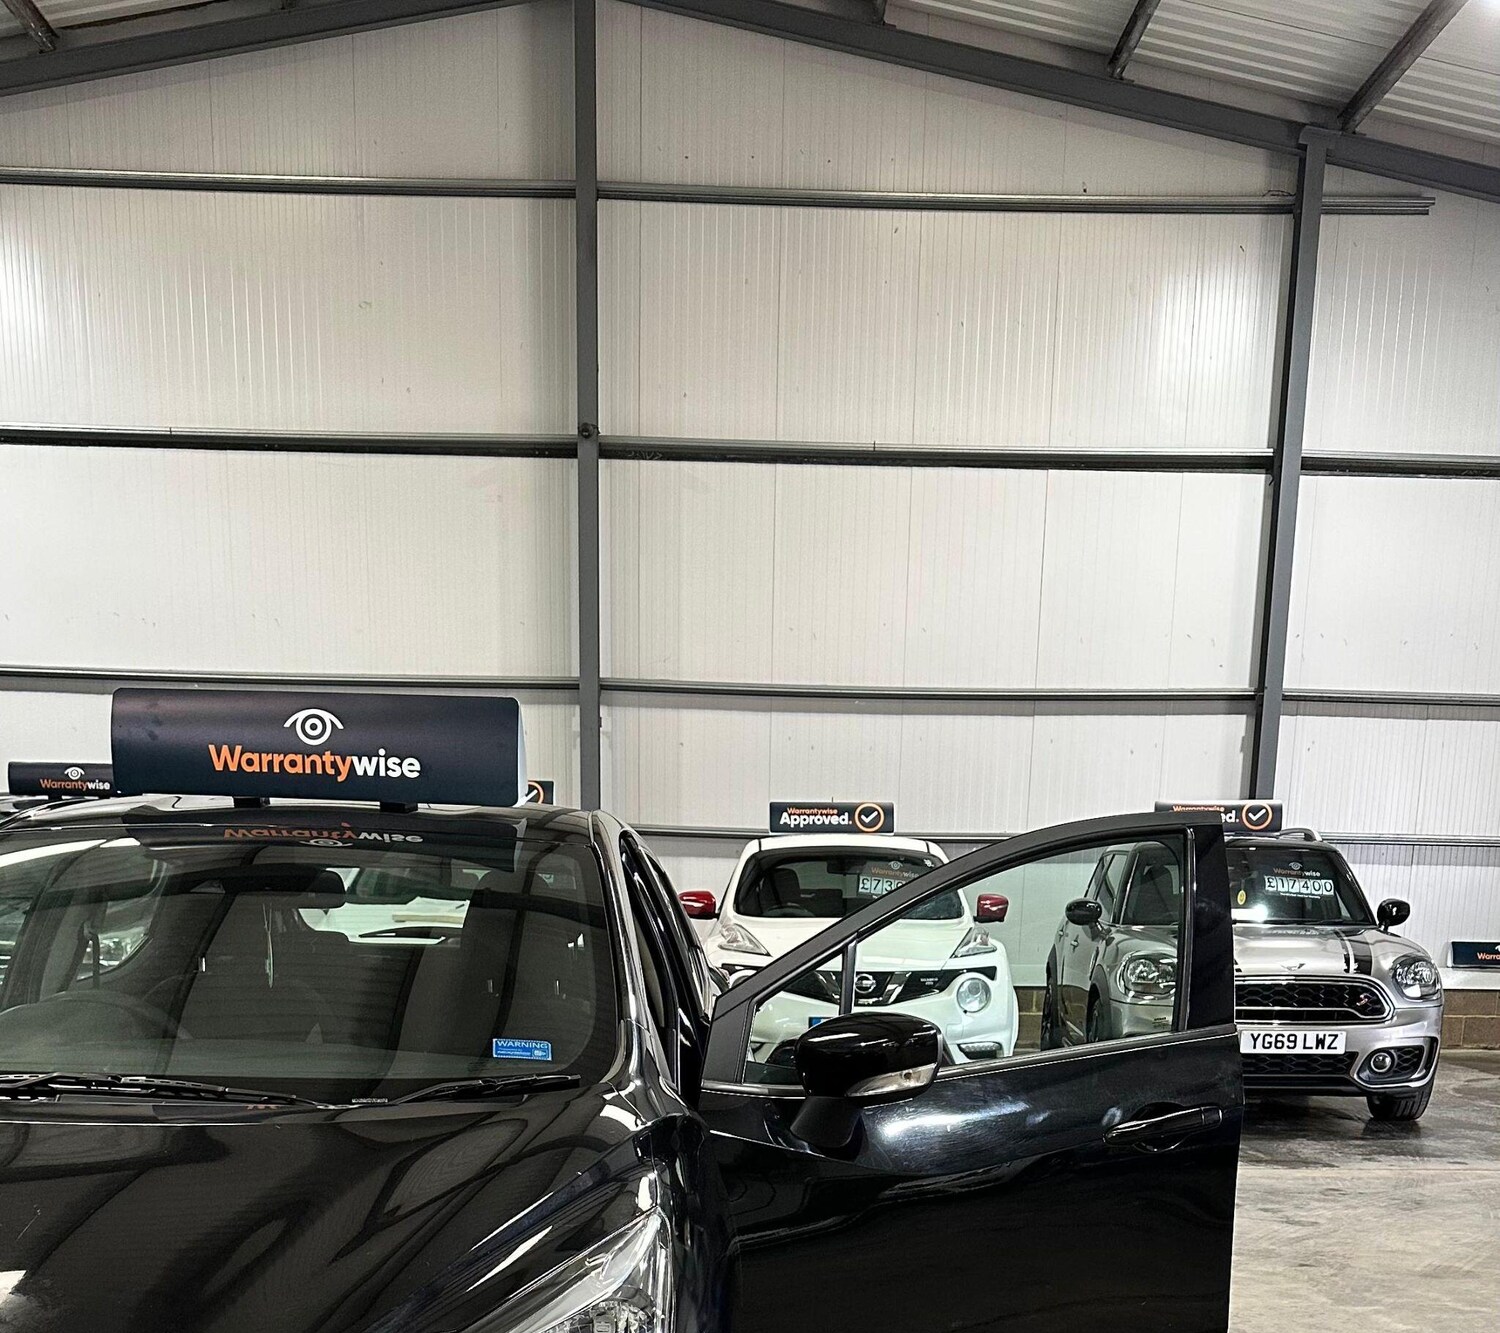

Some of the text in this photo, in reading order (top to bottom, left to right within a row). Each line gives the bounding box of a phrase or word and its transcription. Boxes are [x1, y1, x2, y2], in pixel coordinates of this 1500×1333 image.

[208, 743, 421, 782] Warrantywise
[40, 779, 111, 791] Warrantywise
[787, 807, 838, 816] Warrantywise
[780, 812, 852, 828] Approved.
[1273, 868, 1321, 877] Warrantywise
[1266, 878, 1333, 893] £17400
[497, 1041, 548, 1049] WARNING
[1250, 1033, 1339, 1050] YG69 LWZ
